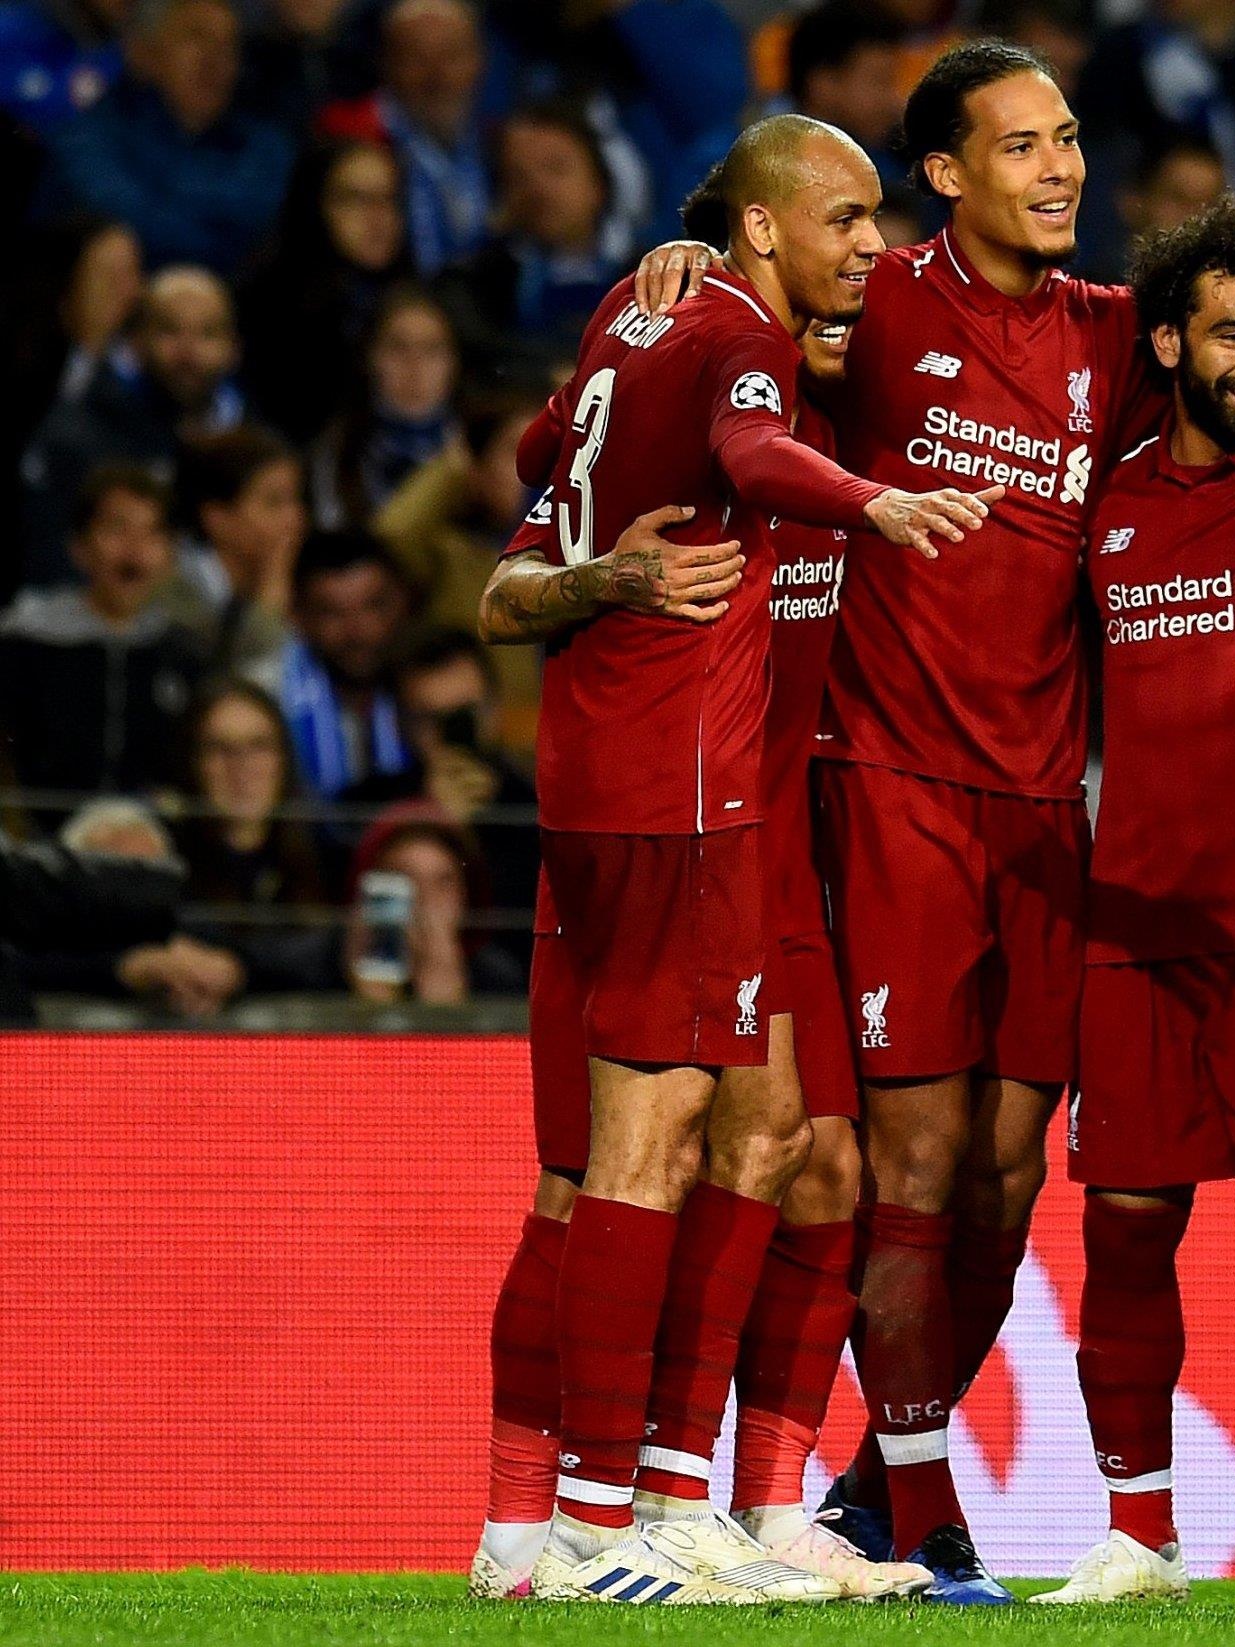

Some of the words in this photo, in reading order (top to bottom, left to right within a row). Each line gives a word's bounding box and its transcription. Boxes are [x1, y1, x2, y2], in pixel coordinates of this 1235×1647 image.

[924, 406, 1061, 466] Standard
[1067, 418, 1093, 434] LFC
[558, 368, 617, 566] 3
[906, 437, 1057, 499] Chartered
[768, 590, 831, 621] rtered
[1107, 569, 1232, 611] Standard
[1106, 603, 1235, 654] Chartered
[735, 1022, 758, 1035] LFC
[862, 1034, 891, 1048] LFC
